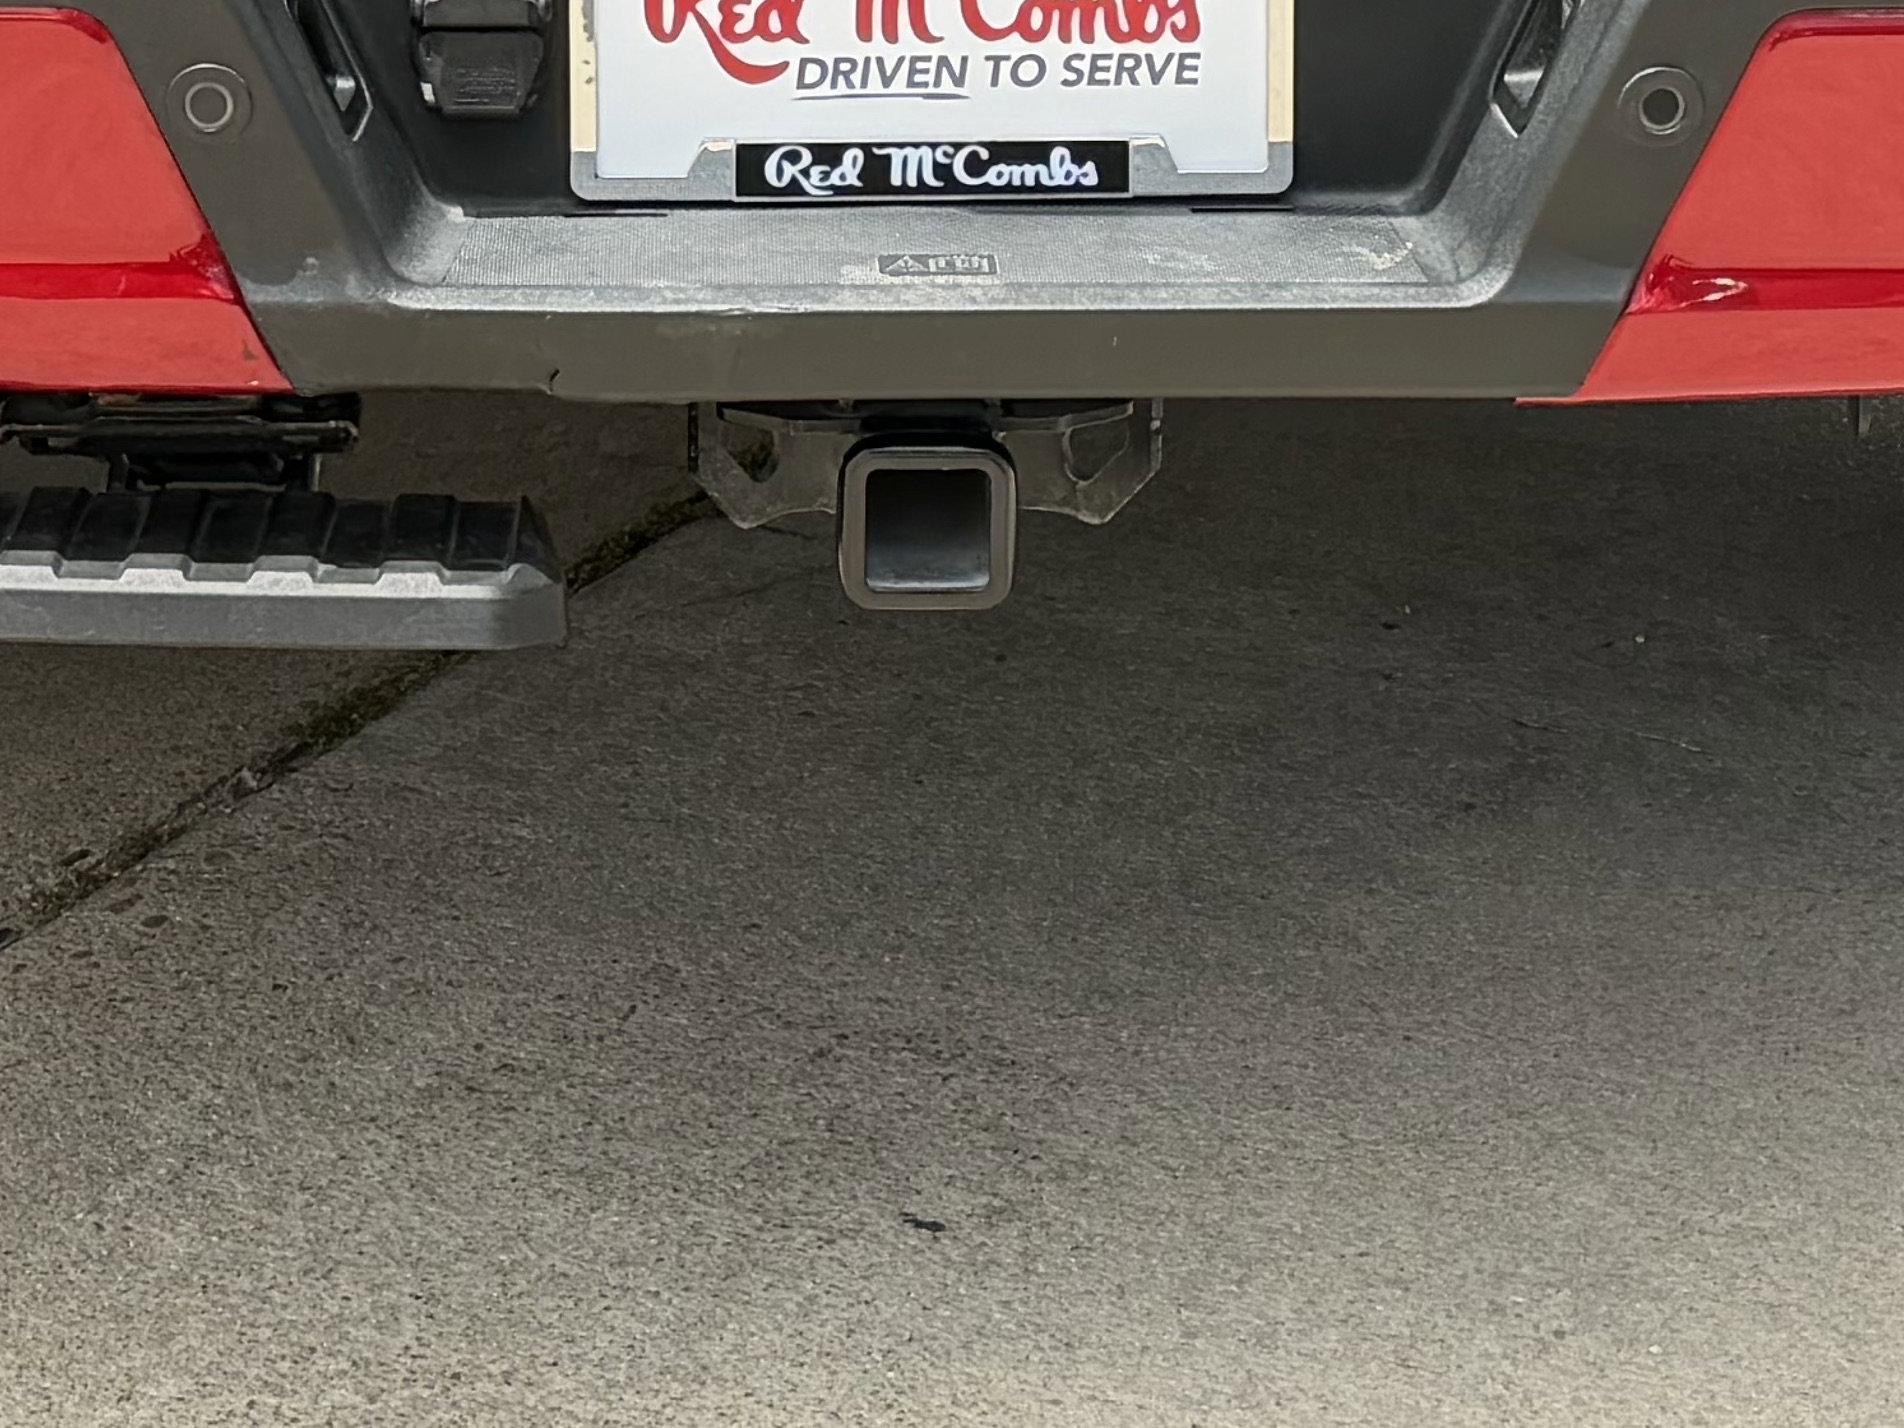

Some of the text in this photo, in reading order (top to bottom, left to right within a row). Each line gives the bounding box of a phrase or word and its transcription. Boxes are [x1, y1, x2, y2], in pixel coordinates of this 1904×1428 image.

[795, 52, 1201, 90] DRIVEN TO SERVE
[764, 144, 1099, 195] Red McCombs
